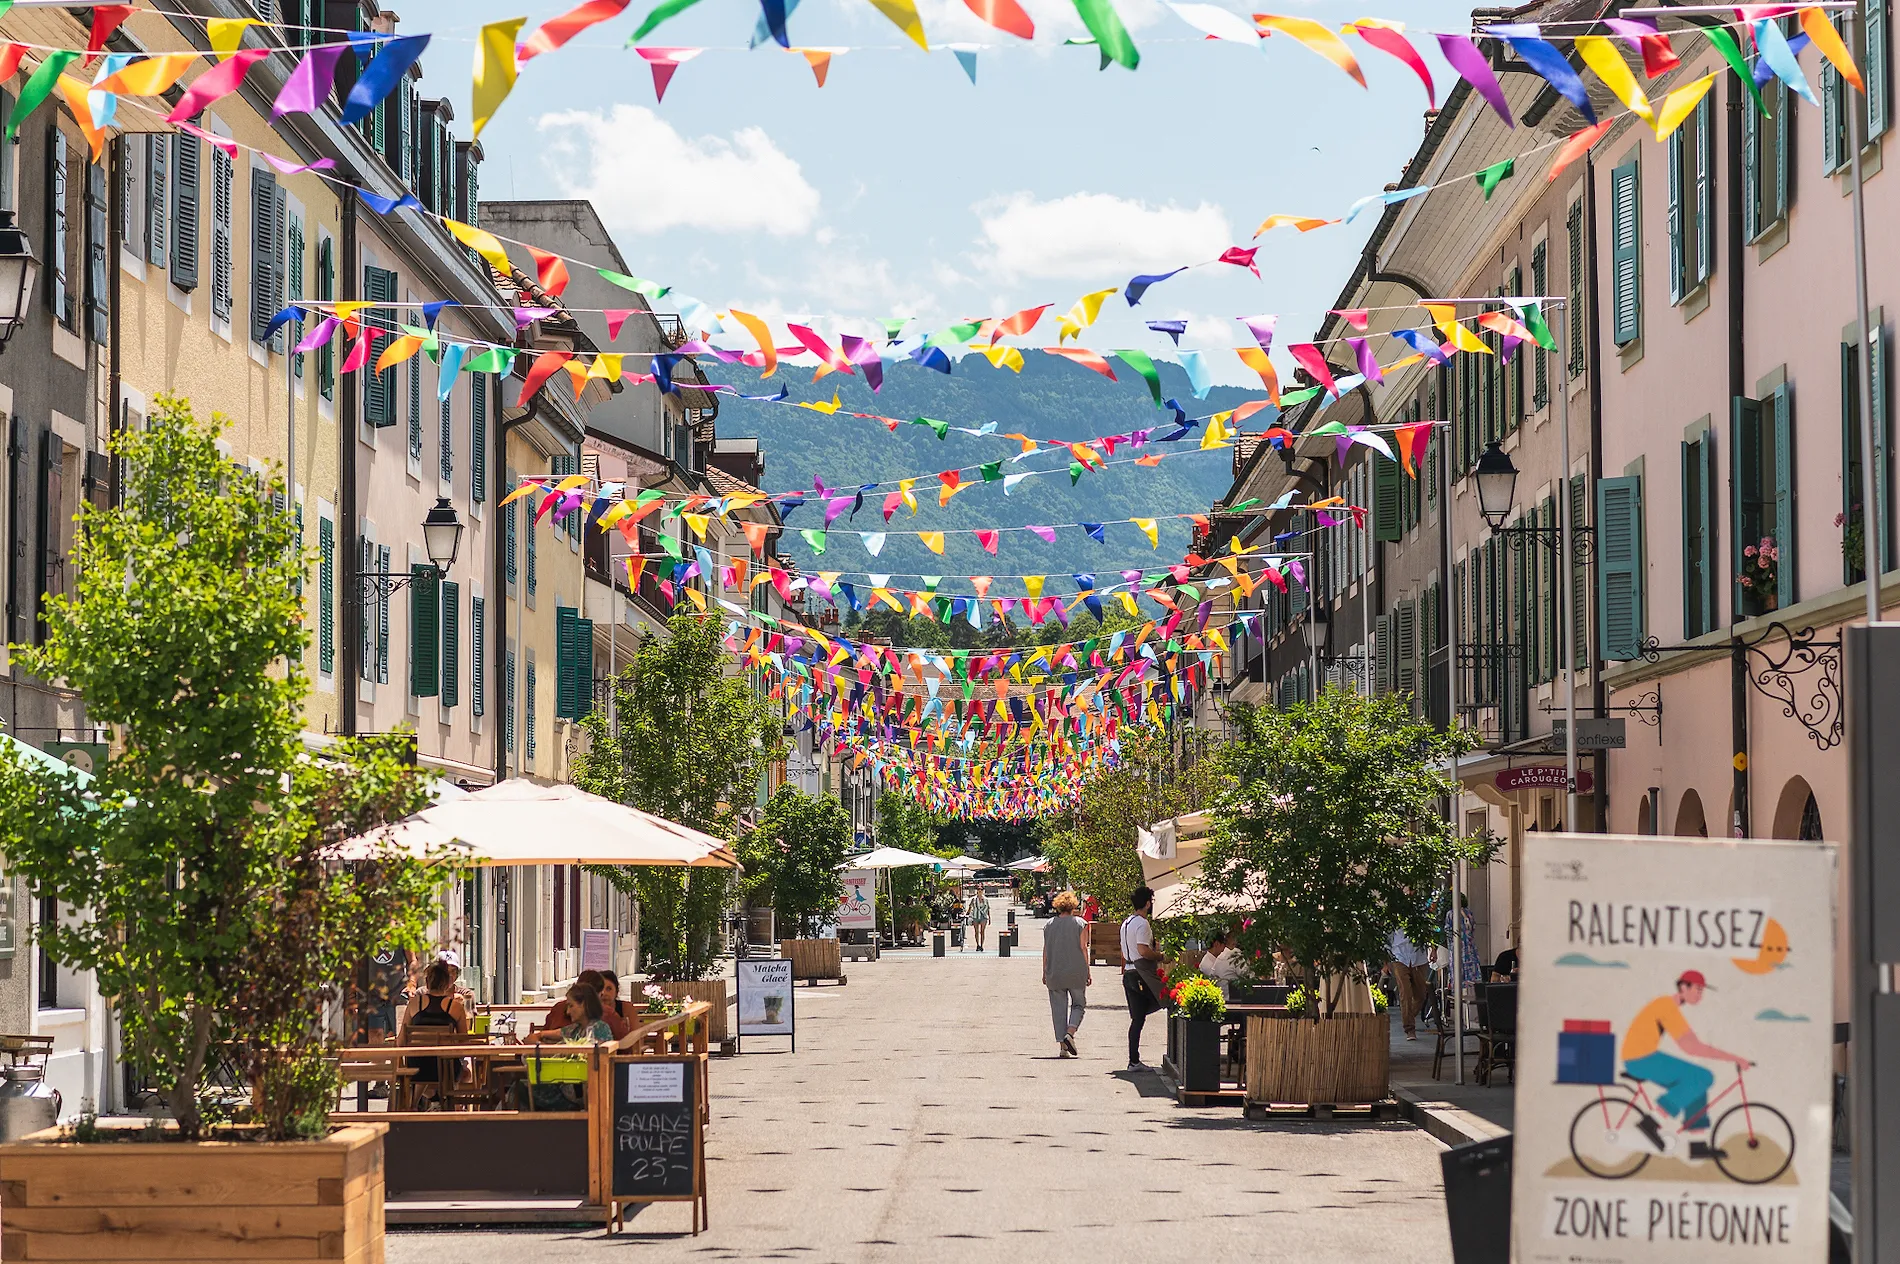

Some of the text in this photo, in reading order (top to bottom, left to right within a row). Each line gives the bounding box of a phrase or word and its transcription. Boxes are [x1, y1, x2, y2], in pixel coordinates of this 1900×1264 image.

[1554, 733, 1625, 746] cionflexe
[1521, 768, 1566, 777] LE P'TIT
[1510, 775, 1567, 786] CAROUGEO
[752, 963, 788, 973] Matcha
[761, 973, 788, 983] Glacé
[619, 1135, 687, 1155] POULPE
[1553, 1190, 1791, 1245] ZONE PIÉTONNE
